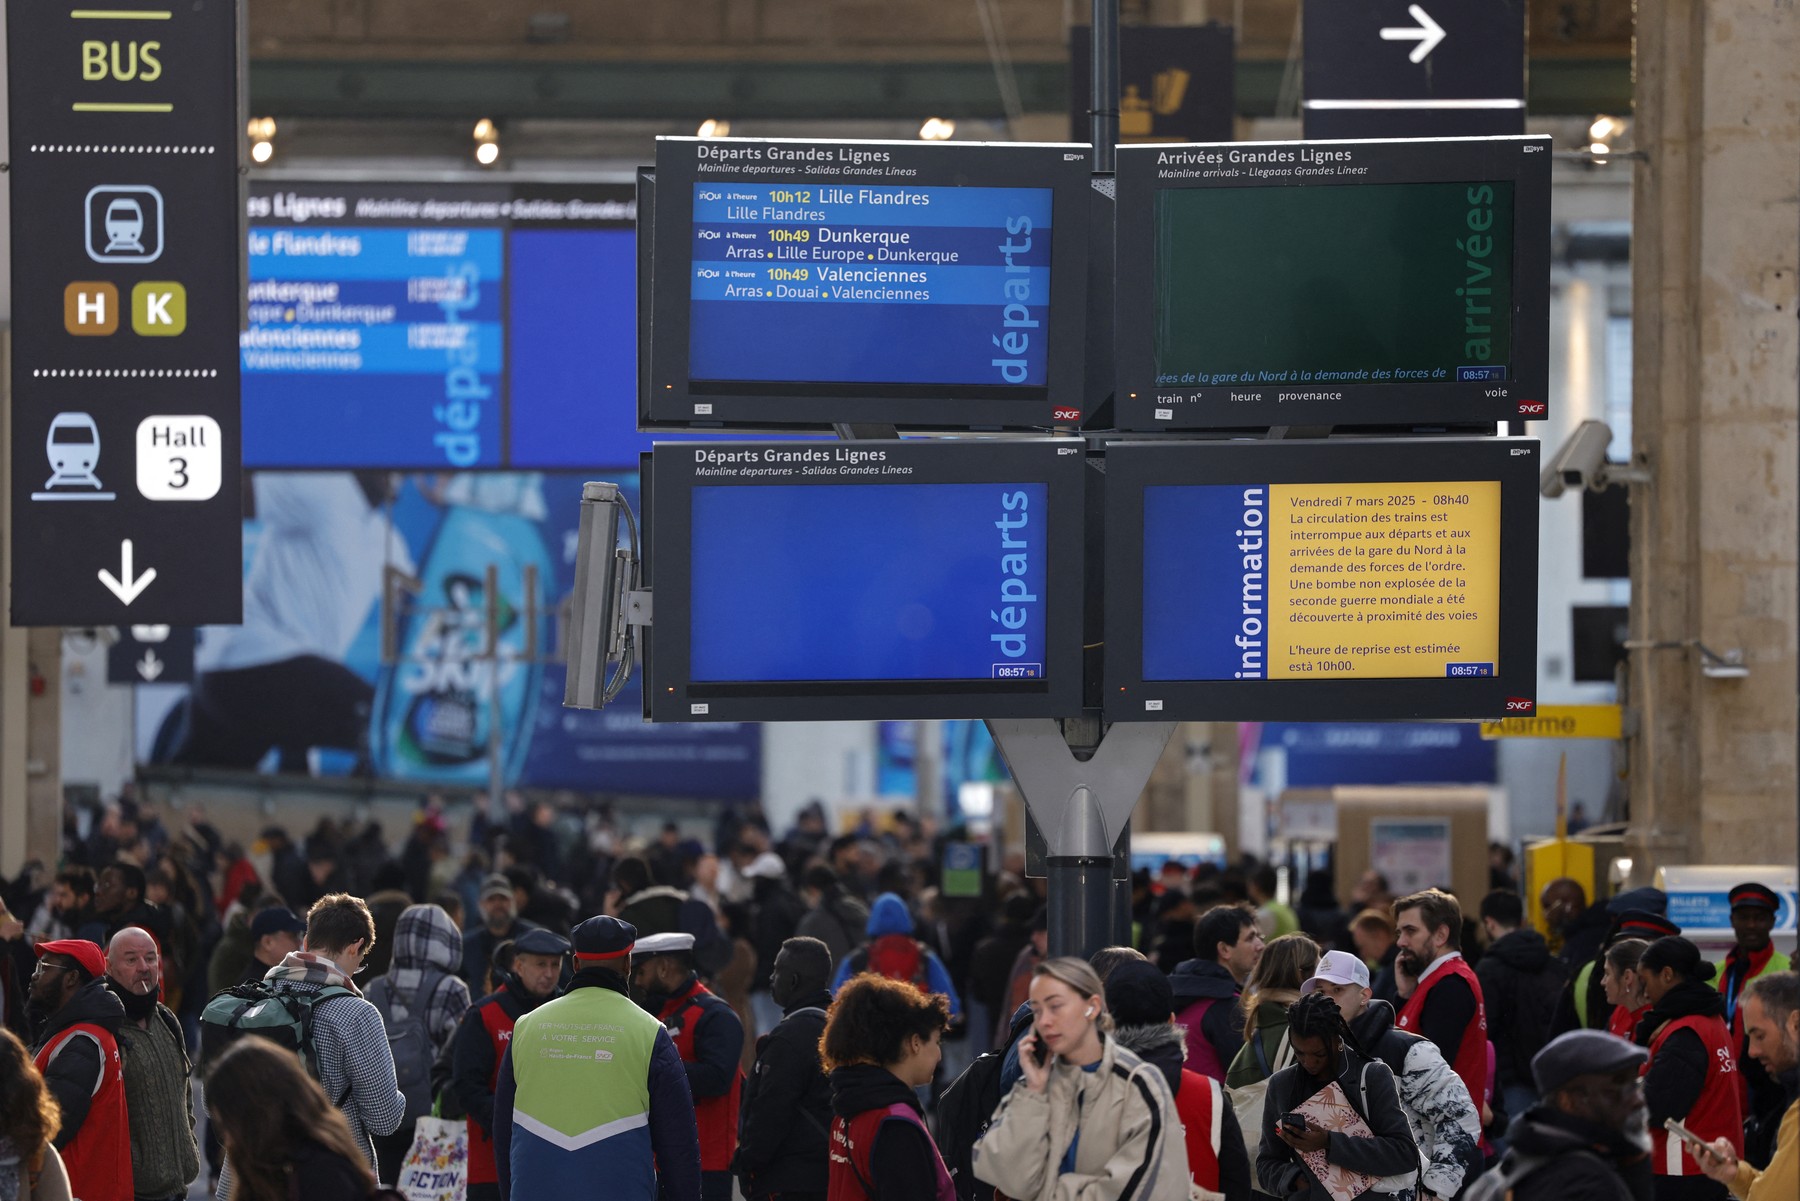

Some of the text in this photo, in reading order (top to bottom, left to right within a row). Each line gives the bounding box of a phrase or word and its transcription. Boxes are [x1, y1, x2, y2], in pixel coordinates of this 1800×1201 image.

[82, 40, 161, 81] BUS
[697, 145, 890, 164] Départs Grandes Lignes
[1157, 148, 1351, 164] Arrivées Grandes Lignes
[697, 163, 916, 176] Mainline departures Salidas Grandes Líneas
[1158, 168, 1200, 178] Mainline
[1202, 167, 1239, 177] arrivals
[1294, 166, 1334, 175] Grandes
[769, 190, 810, 203] 10h12
[819, 189, 853, 204] Lille
[859, 189, 929, 205] Flandres
[273, 192, 347, 222] Lignes
[727, 206, 825, 220] Lille Flandres
[272, 231, 362, 257] Flandres
[768, 229, 809, 242] 10h49
[818, 228, 909, 246] Dunkerque
[725, 245, 958, 262] Arras Lille Europe Dunkerque
[767, 268, 808, 280] 10h49
[816, 267, 927, 282] Valenciennes
[1456, 185, 1494, 360] arrivées
[724, 283, 929, 300] Arras Douai Valenciennes
[992, 215, 1039, 383] départs
[78, 292, 172, 324] H K
[243, 351, 362, 371] Valenciennes
[433, 262, 493, 468] départs
[1180, 372, 1196, 383] de
[1197, 372, 1209, 382] la
[1210, 373, 1237, 385] gare
[1240, 371, 1255, 381] du
[1258, 370, 1287, 381] Nord
[1290, 370, 1297, 380] à
[1300, 370, 1311, 380] la
[1314, 369, 1368, 381] demande
[1372, 368, 1391, 379] des
[1394, 368, 1428, 379] forces
[1432, 368, 1446, 378] de
[1463, 370, 1490, 380] 08:57
[1157, 392, 1202, 403] train n°
[1230, 392, 1261, 401] heure
[1278, 392, 1341, 402] provenance
[1484, 387, 1507, 397] voie
[1054, 410, 1080, 419] SNCF
[1518, 404, 1544, 413] SNCF
[152, 426, 204, 446] Hall
[695, 448, 886, 465] Départs Grandes Lignes
[168, 457, 189, 488] 3
[695, 465, 912, 477] Mainline departures Salidas Grandes Líneas
[1290, 494, 1469, 507] Vendredi 7 mars 2025 08h40
[1290, 511, 1447, 523] La circulation des trains est
[1290, 528, 1470, 542] interrompue aux départs et aux
[1289, 544, 1466, 558] arrivées de la gare du Nord à la
[990, 490, 1036, 658] départs
[1289, 561, 1465, 573] demande des forces de l'ordre.
[1234, 488, 1262, 678] information
[1290, 577, 1466, 590] Une bombe non explosée de la
[1289, 593, 1465, 608] seconde guerre mondiale a été
[1289, 609, 1477, 623] découverte à proximité des voies
[1289, 643, 1460, 656] L'heure de reprise est estimée
[998, 668, 1025, 676] 08:57
[1289, 660, 1355, 671] està 10h00.
[1452, 666, 1478, 676] 08:57
[1506, 701, 1532, 710] SNCF
[1486, 715, 1577, 735] Alarme
[552, 1034, 577, 1042] VOTRE
[582, 1035, 616, 1043] SERVICE
